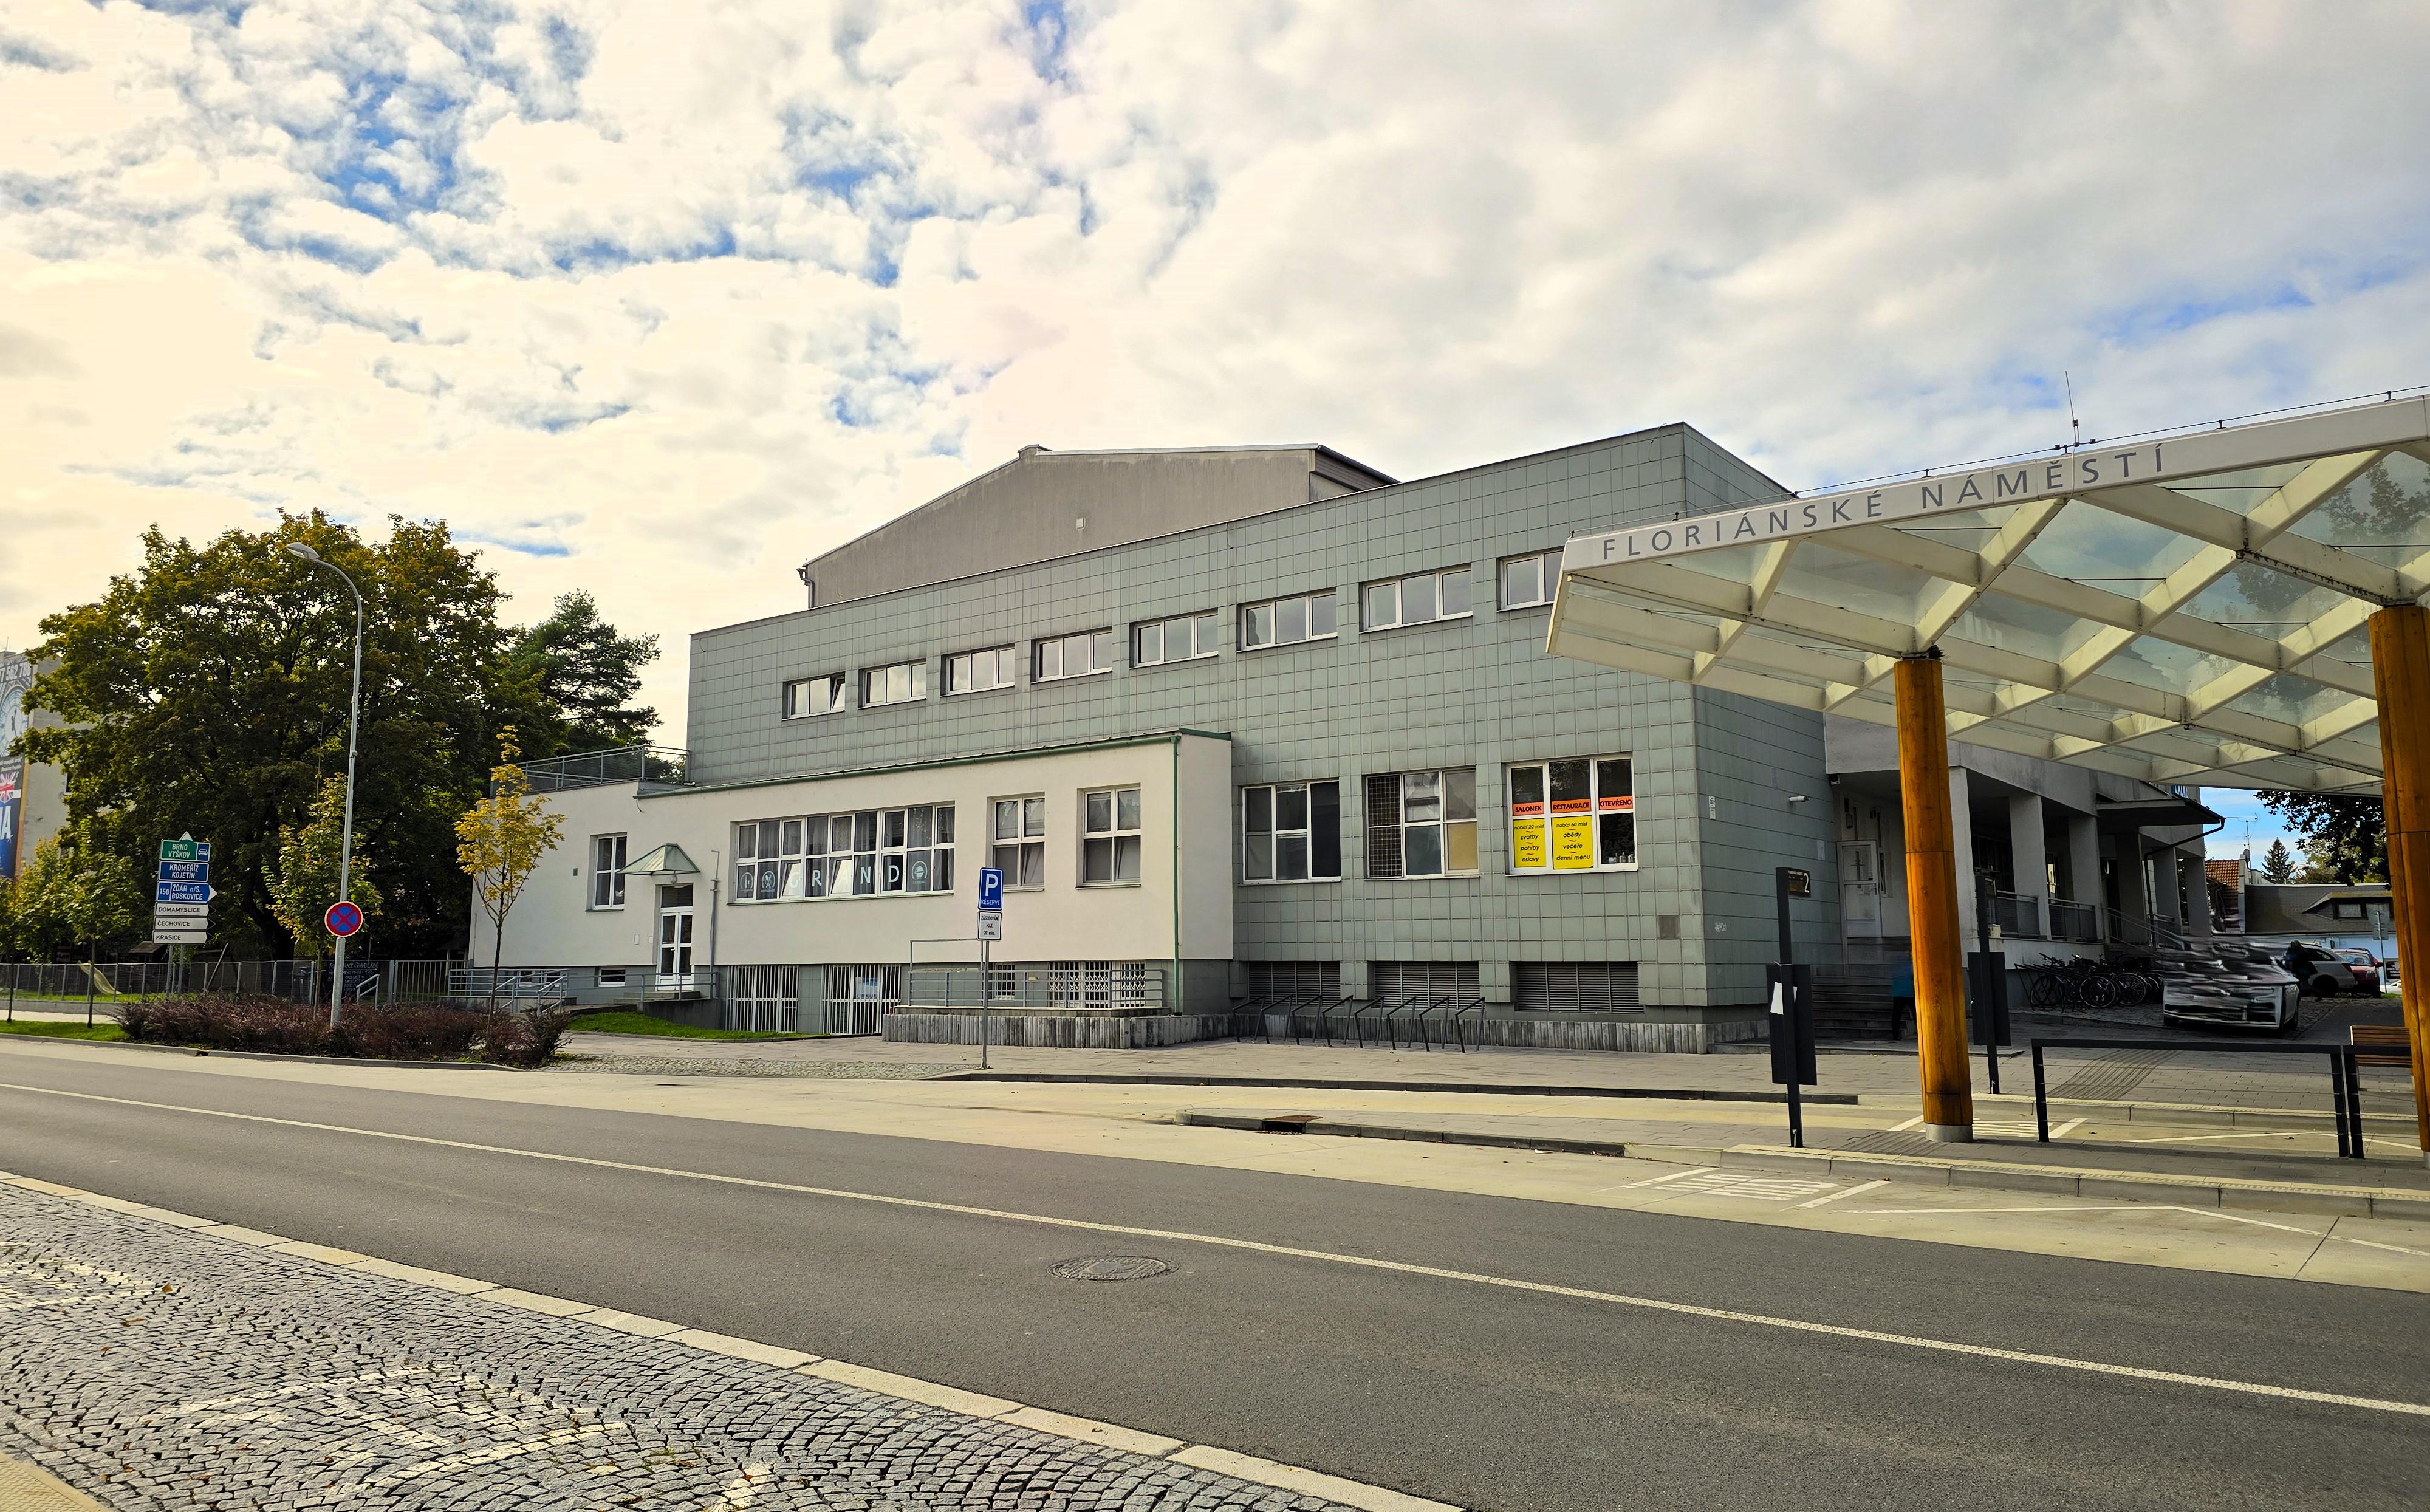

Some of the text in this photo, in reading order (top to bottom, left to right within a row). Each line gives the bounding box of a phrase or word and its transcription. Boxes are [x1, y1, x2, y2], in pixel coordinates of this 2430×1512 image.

[1603, 443, 2164, 559] FLORIÁNSKÉ NÁMĚSTÍ
[168, 850, 190, 858] VYŠKOV
[169, 864, 199, 872] KROMĚŘÍŽ
[790, 865, 900, 889] GRAND
[985, 874, 999, 897] P
[1804, 872, 1810, 893] 2
